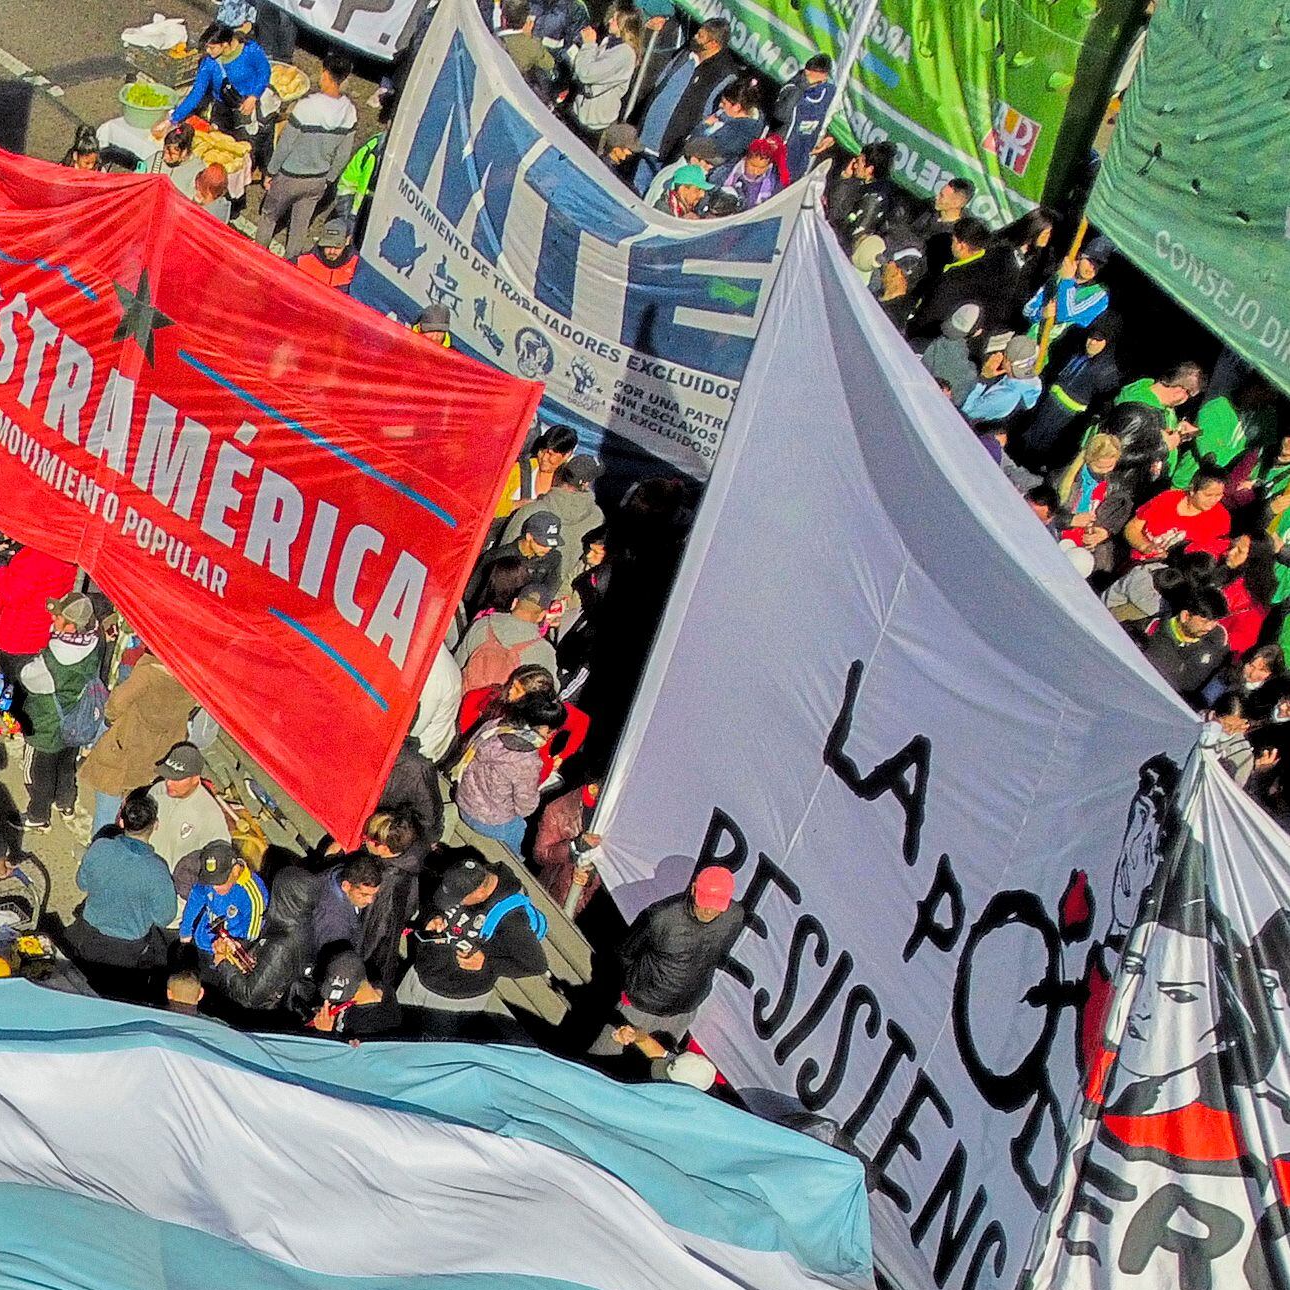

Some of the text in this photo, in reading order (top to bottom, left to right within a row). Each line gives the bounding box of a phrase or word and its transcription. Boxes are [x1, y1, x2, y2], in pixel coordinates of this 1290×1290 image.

[404, 29, 783, 381] MTE
[397, 178, 469, 262] MOVIMIENTO
[471, 257, 491, 279] DE
[494, 274, 621, 363] TRABAJADORES
[1156, 230, 1261, 330] CONSEJO
[613, 393, 639, 410] SIN
[641, 401, 718, 444] ESCLAVOS
[614, 379, 645, 399] POR
[648, 391, 680, 414] UNA
[630, 414, 717, 460] EXCLUIDOS!
[121, 505, 229, 598] POPULAR
[824, 659, 932, 866] LA
